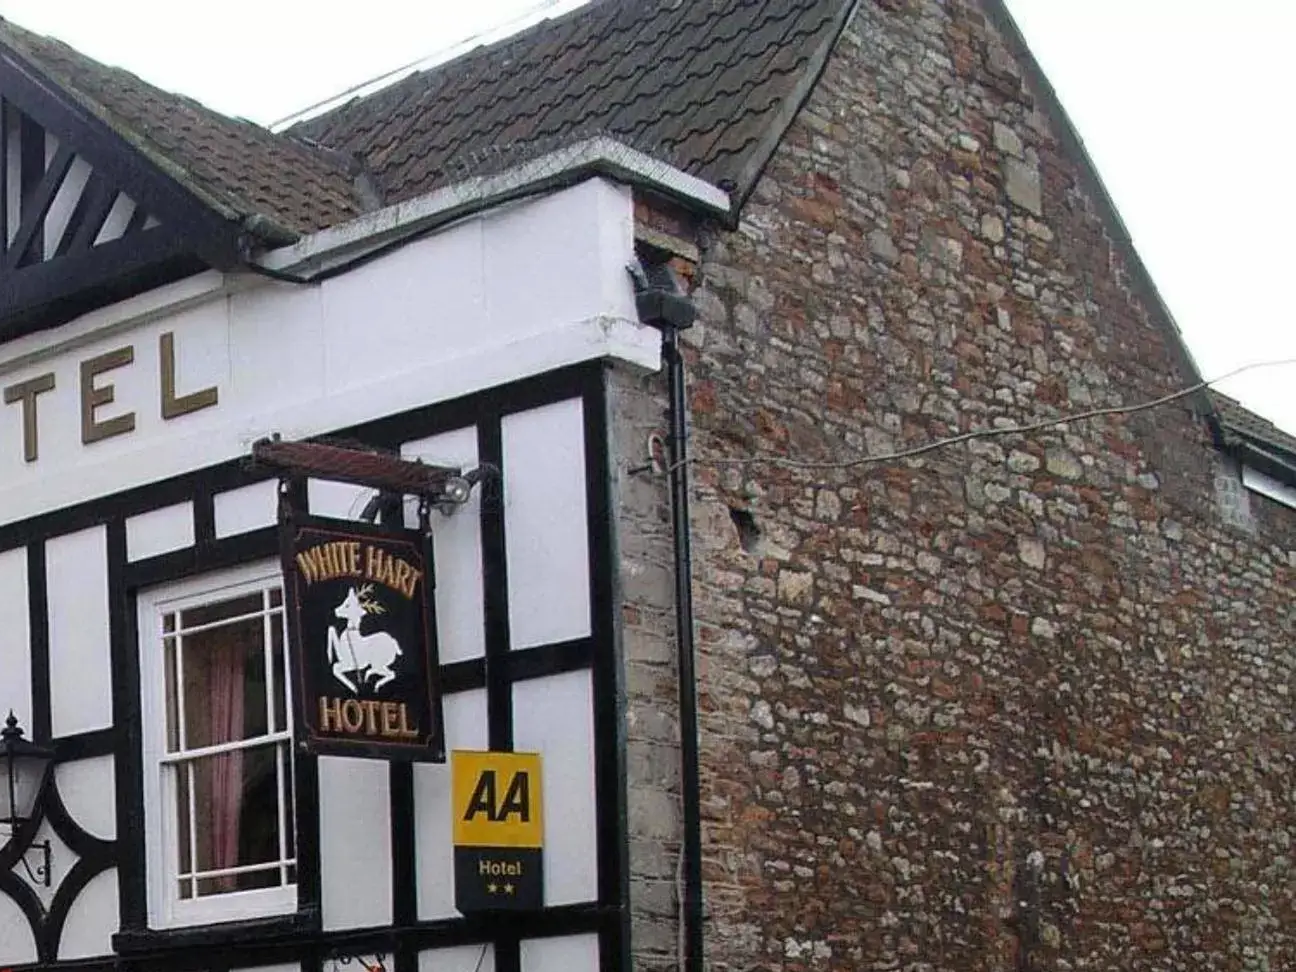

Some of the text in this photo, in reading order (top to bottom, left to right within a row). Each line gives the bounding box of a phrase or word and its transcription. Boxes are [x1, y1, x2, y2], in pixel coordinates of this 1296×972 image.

[296, 541, 423, 600] WHITE HART
[319, 696, 419, 736] HOTEL
[463, 770, 530, 822] AA
[479, 860, 521, 875] Hotel
